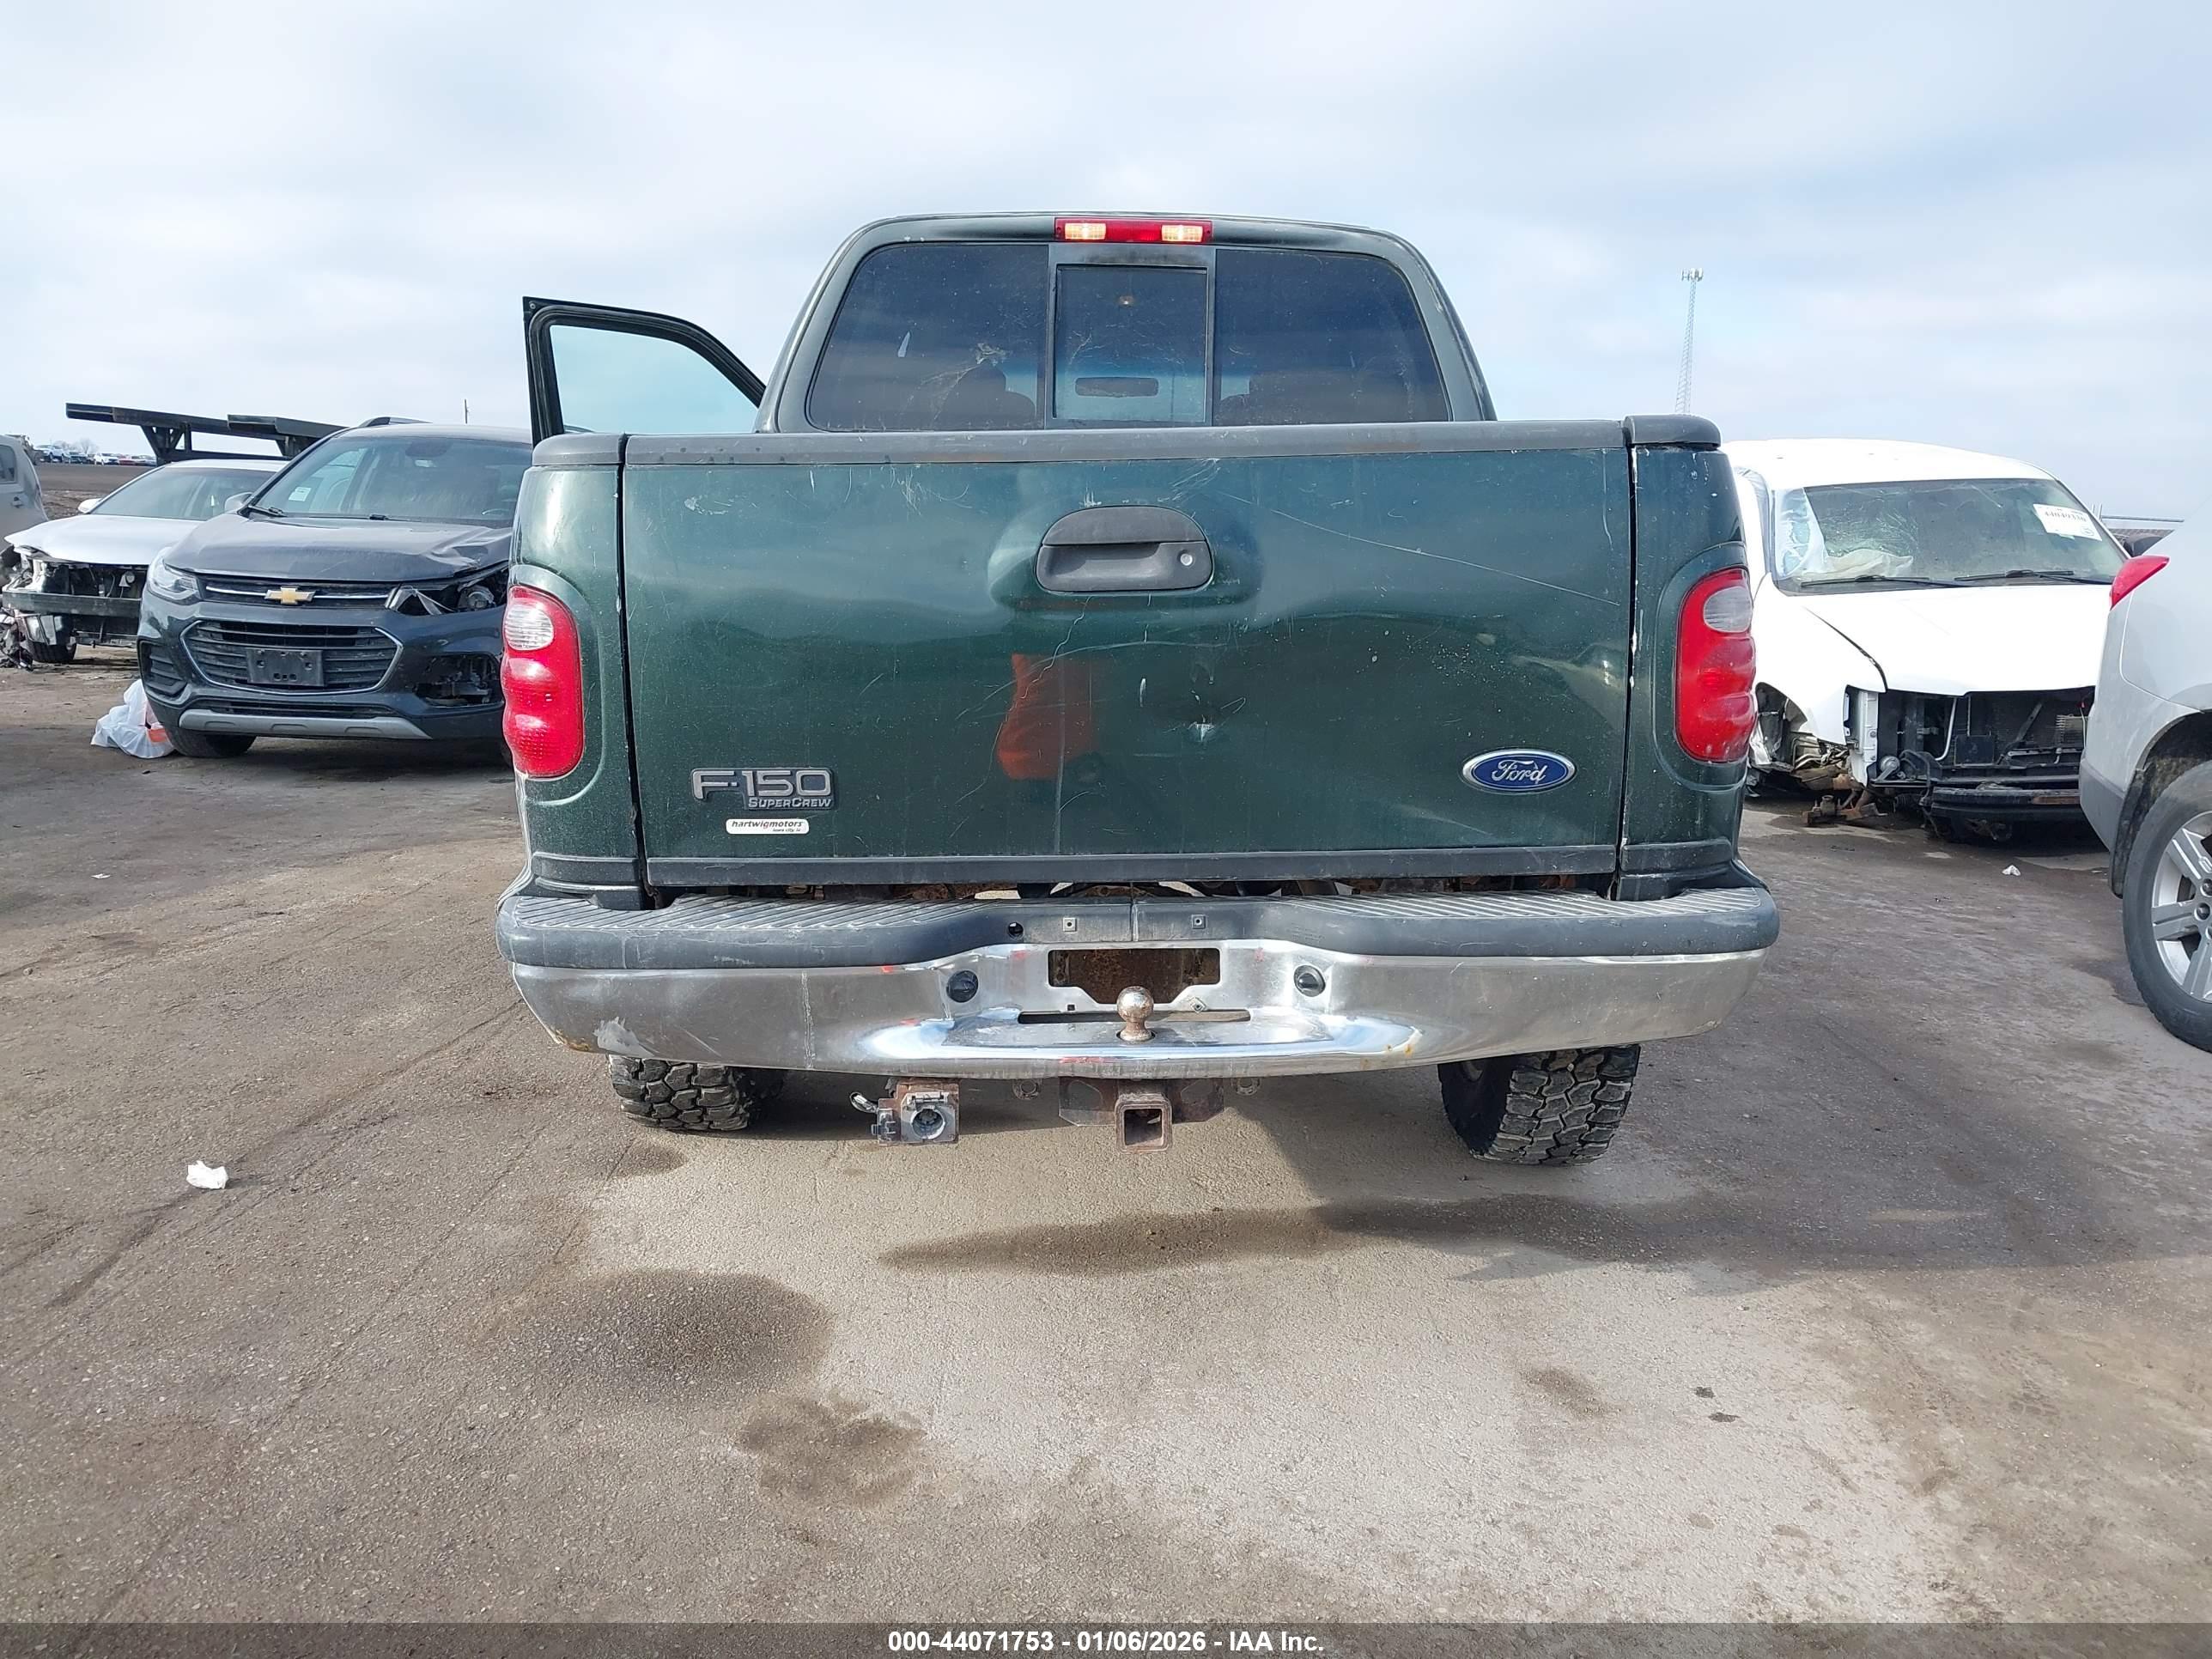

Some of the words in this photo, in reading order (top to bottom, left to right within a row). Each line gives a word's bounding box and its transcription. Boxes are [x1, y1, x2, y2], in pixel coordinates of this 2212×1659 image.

[692, 769, 832, 799] F-150
[1491, 759, 1548, 785] Ford
[732, 820, 803, 830] hartwigmotors
